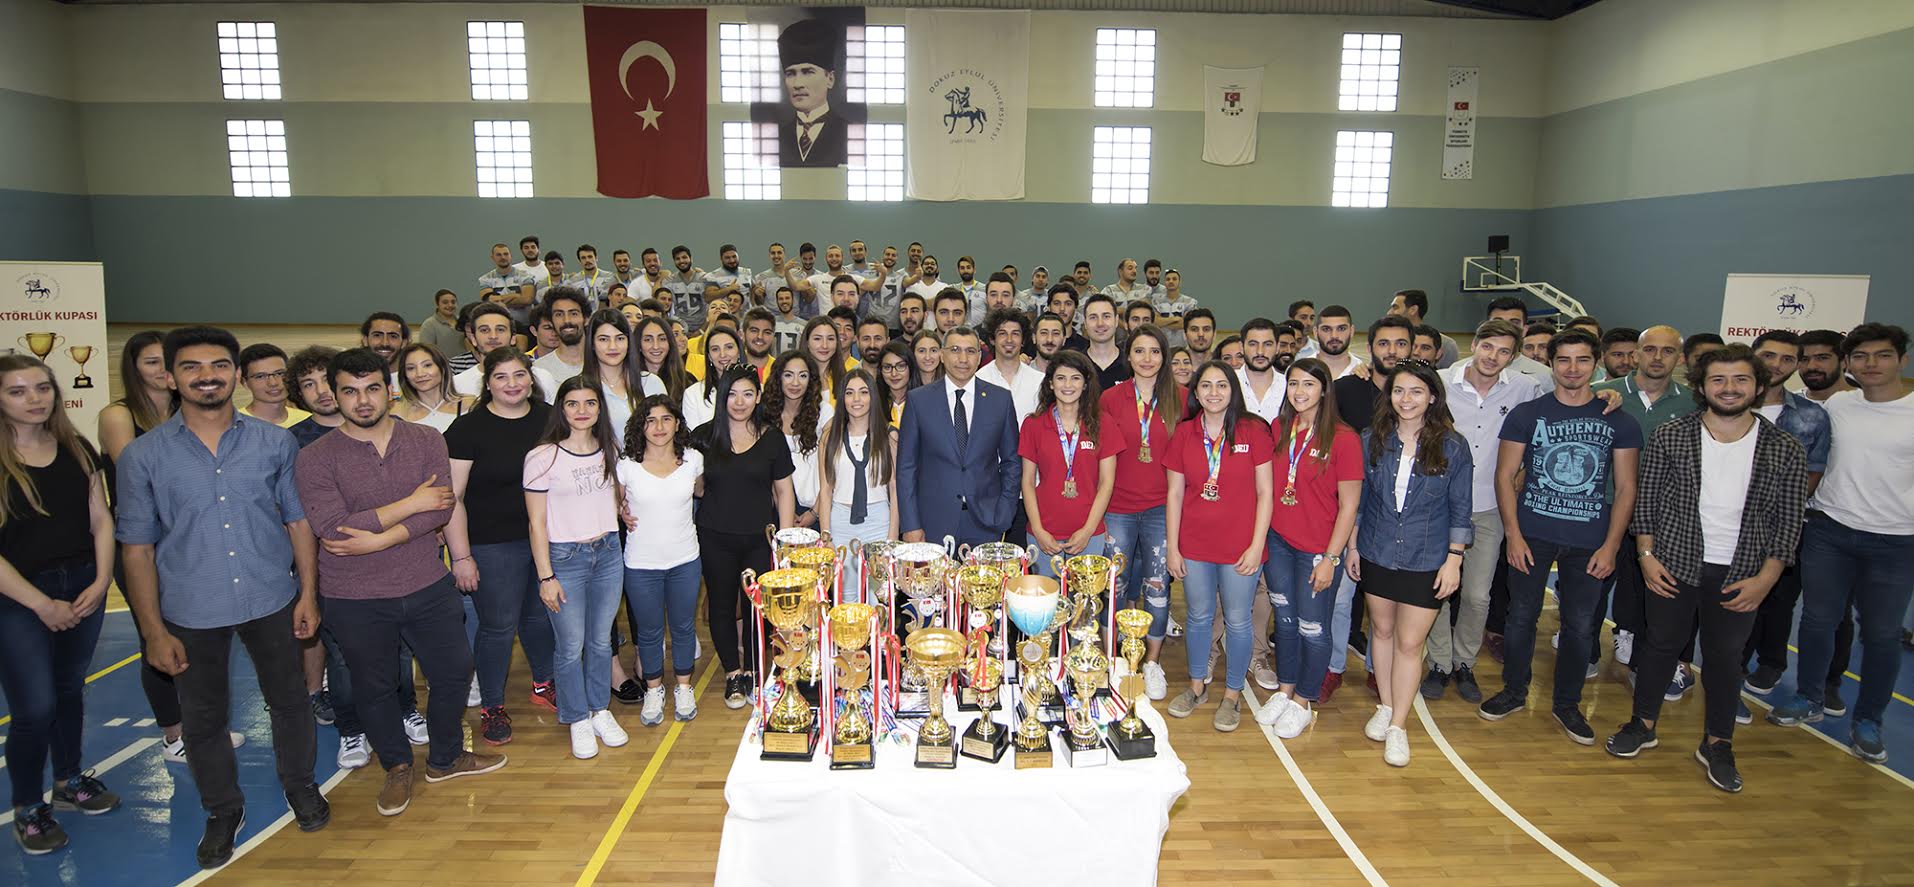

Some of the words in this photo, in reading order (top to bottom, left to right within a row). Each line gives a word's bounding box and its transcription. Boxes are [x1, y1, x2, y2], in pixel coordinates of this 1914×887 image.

[929, 71, 955, 94] DOKUZ
[55, 311, 97, 320] KUPASI
[1531, 418, 1615, 447] AUTHENTIC
[1080, 440, 1095, 450] DE
[1533, 494, 1549, 504] THE
[1550, 498, 1594, 511] ULTIMATE
[1548, 505, 1600, 519] CHAMPIONSHIPS
